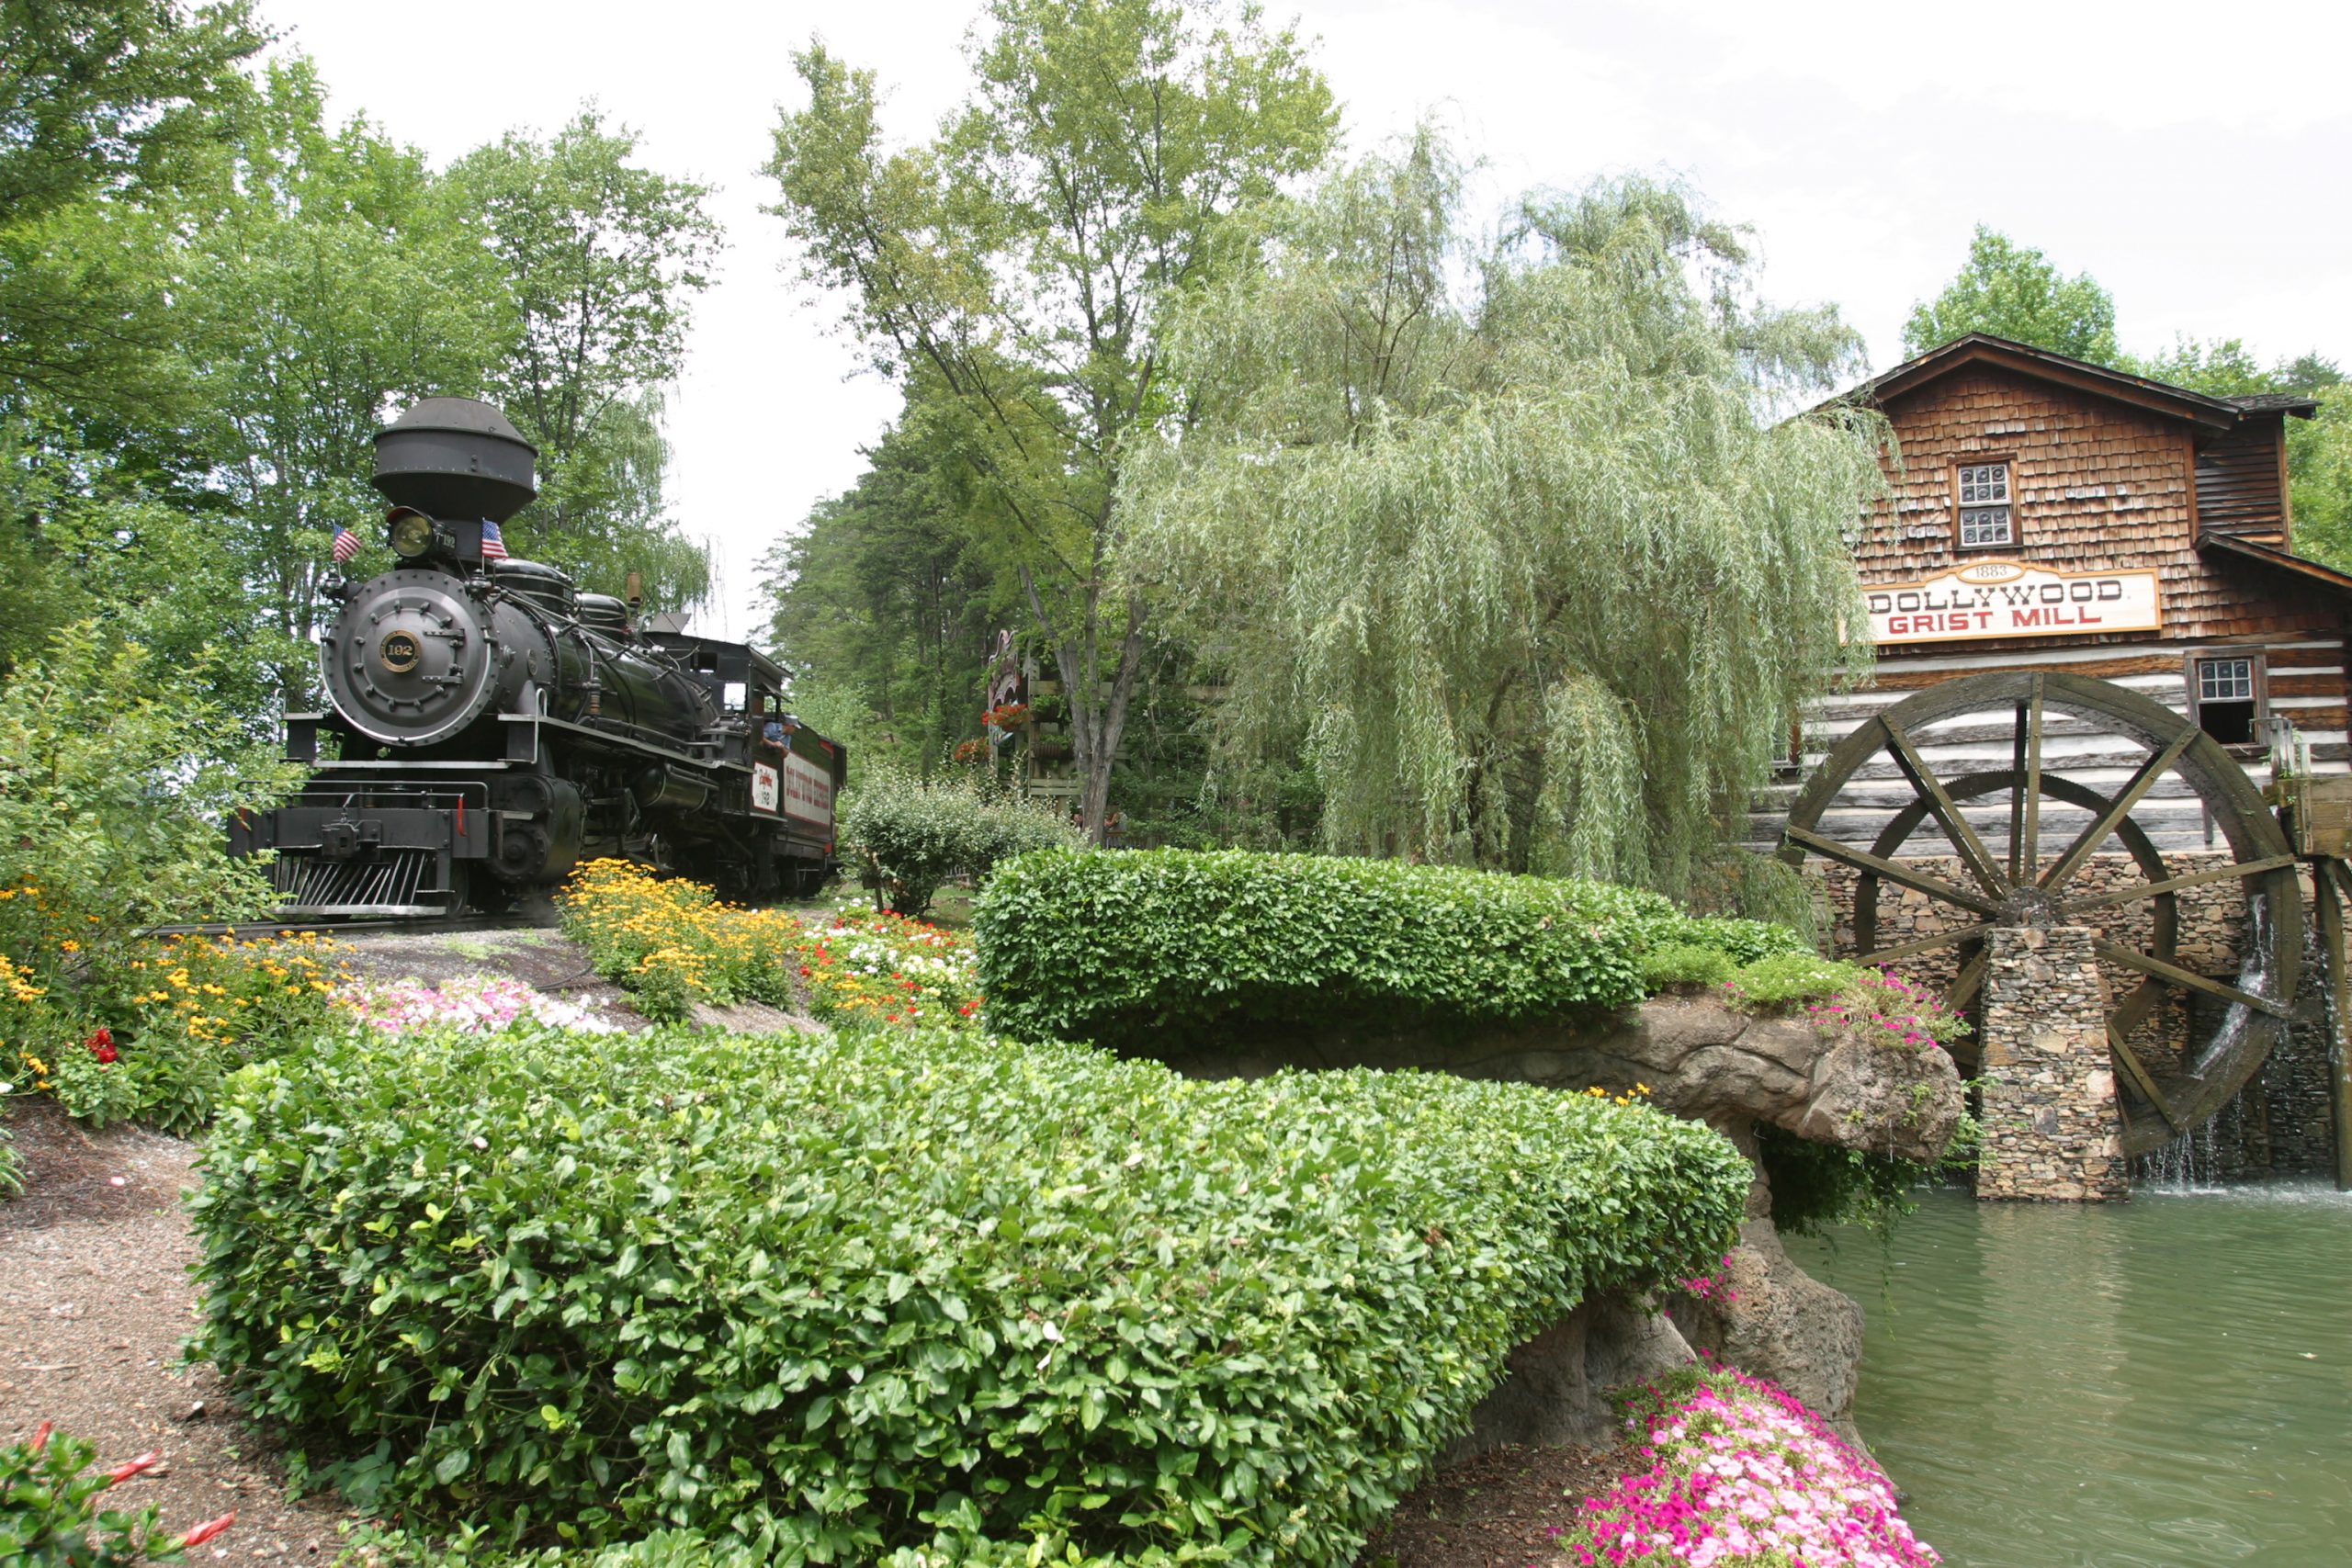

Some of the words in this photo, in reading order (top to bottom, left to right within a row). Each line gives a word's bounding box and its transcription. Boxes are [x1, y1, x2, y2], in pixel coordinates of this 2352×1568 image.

[1975, 565, 2007, 578] 1883
[1869, 581, 2122, 614] DOLLYWOOD
[1889, 611, 1994, 635] GRIST
[2012, 606, 2102, 627] MILL
[388, 644, 413, 656] 192
